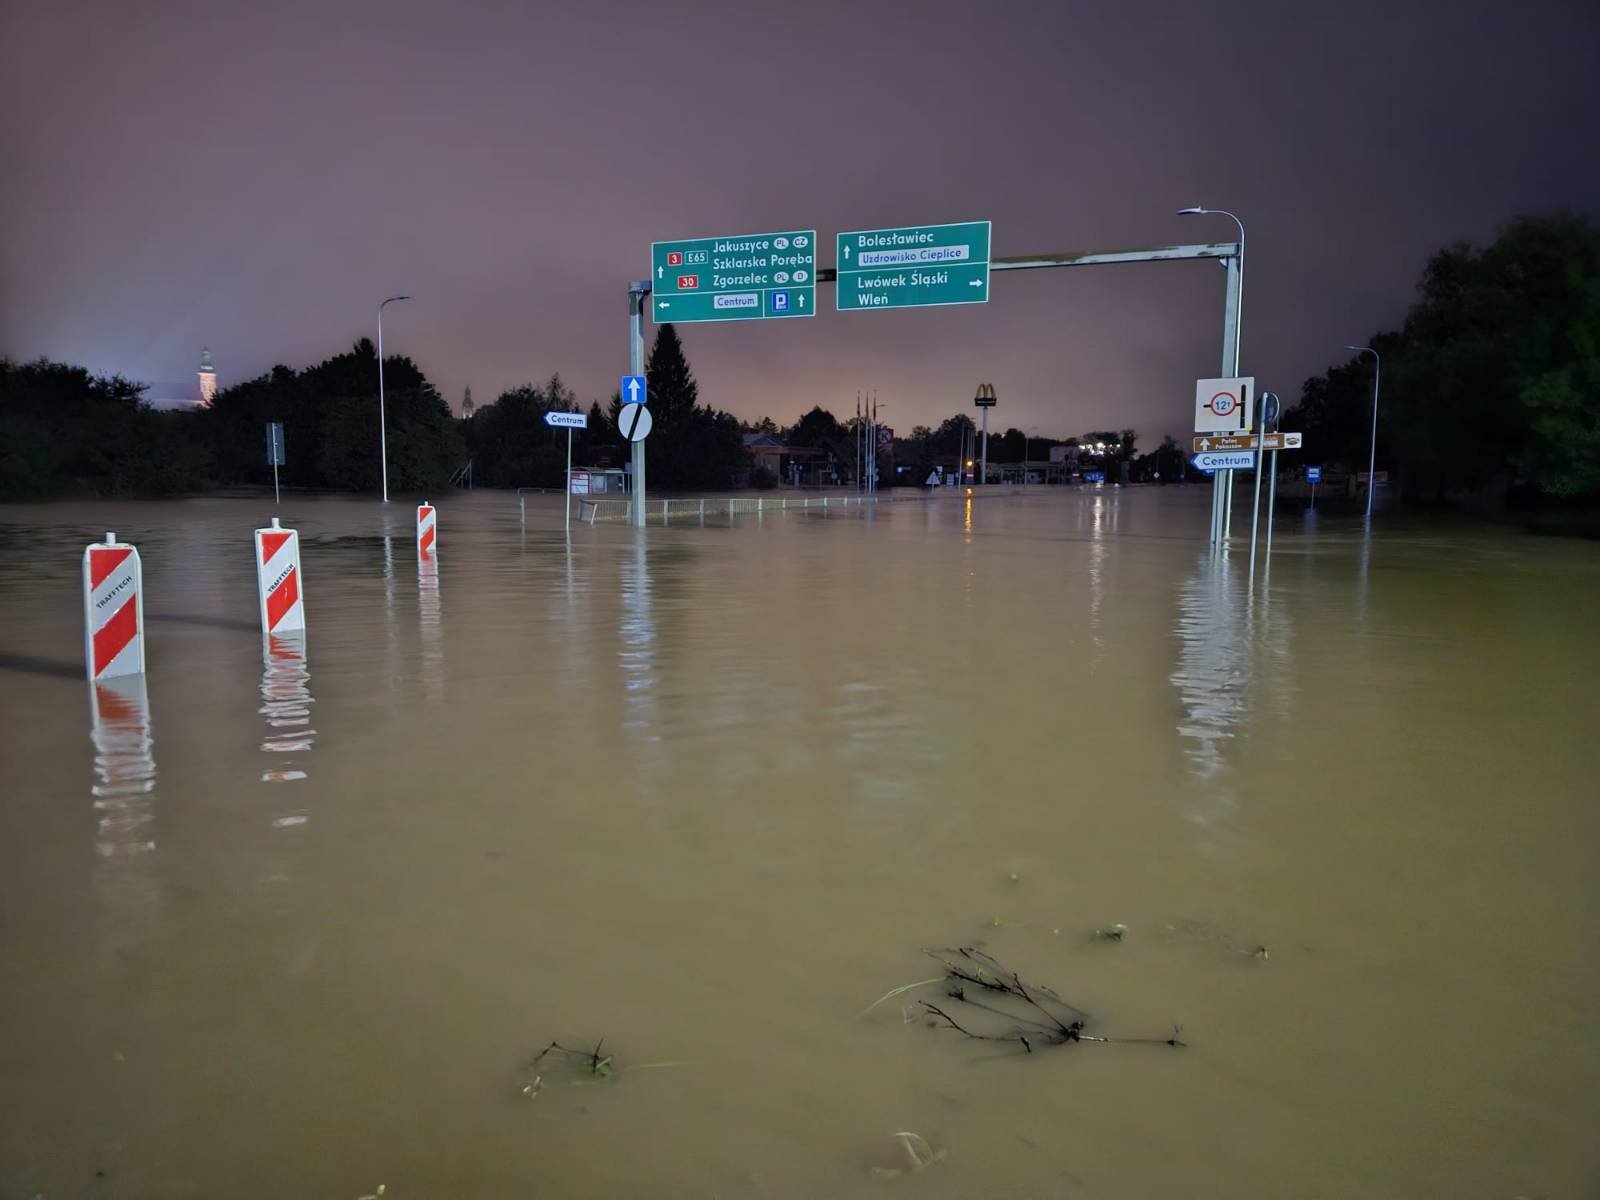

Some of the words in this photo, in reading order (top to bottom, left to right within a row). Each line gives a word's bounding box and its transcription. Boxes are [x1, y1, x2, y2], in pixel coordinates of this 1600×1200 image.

[713, 240, 769, 253] Jakuszyce
[795, 238, 806, 246] CZ
[858, 231, 934, 247] Bolesławiec
[671, 255, 678, 264] 3
[688, 253, 705, 263] E65
[713, 257, 767, 270] Szklarska
[771, 253, 813, 267] Poręba
[863, 252, 917, 264] Uzdrowisko
[920, 248, 961, 262] Cieplice
[682, 277, 694, 287] 30
[713, 273, 768, 289] Zgorzelec
[797, 272, 804, 280] D
[858, 275, 906, 289] Lwówek
[910, 270, 948, 287] Śląski
[717, 296, 755, 307] Centrum
[858, 292, 889, 306] Wleń
[551, 415, 584, 425] Centrum
[1202, 456, 1250, 466] Centrum
[96, 575, 133, 609] TRAFFTECH
